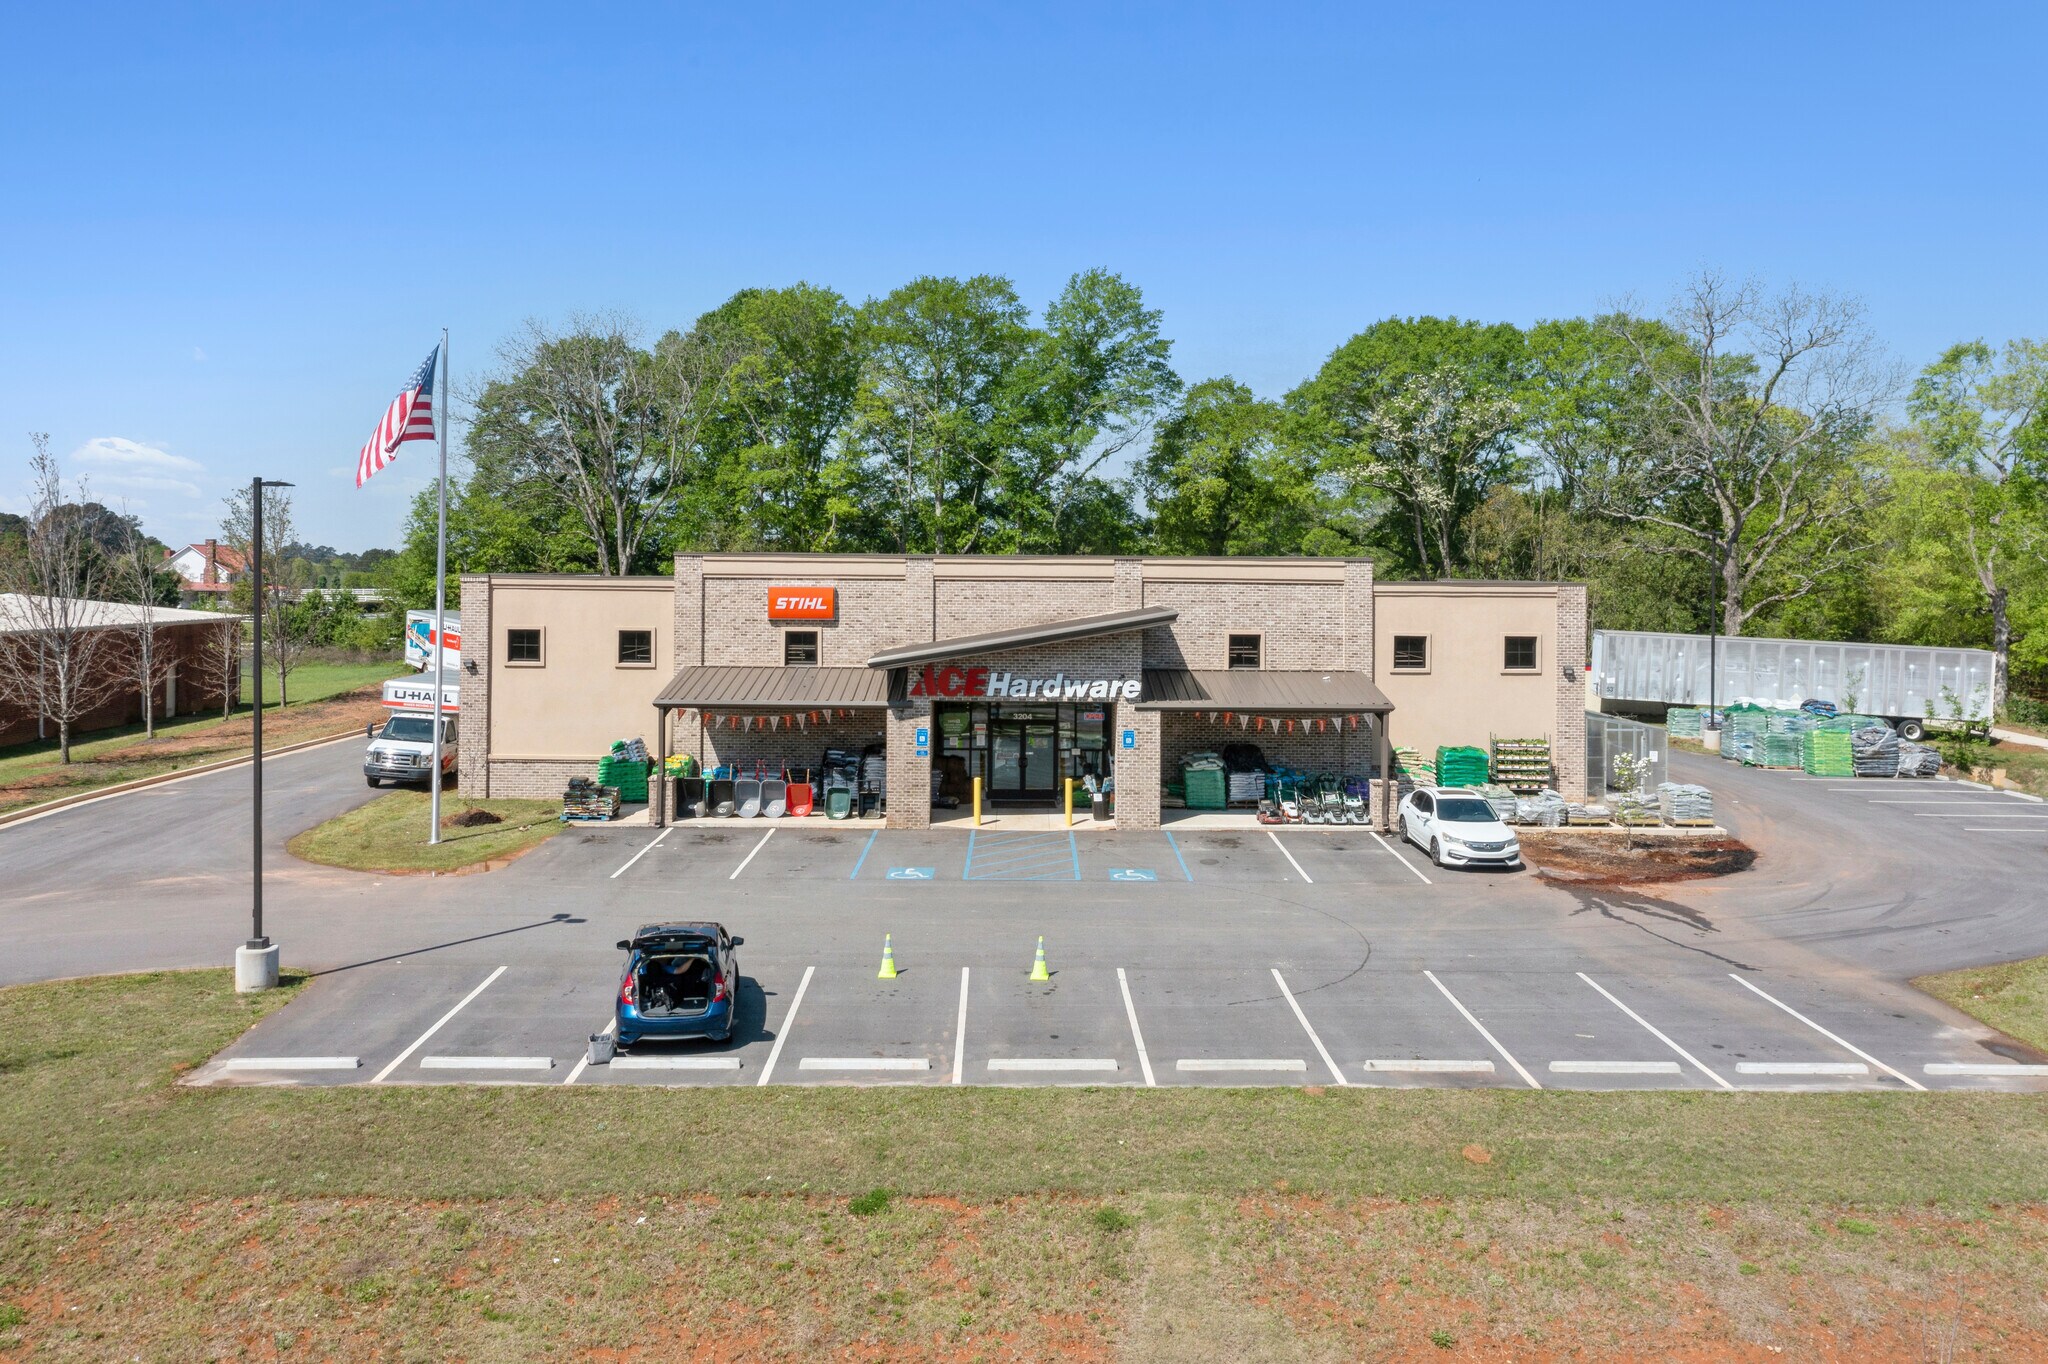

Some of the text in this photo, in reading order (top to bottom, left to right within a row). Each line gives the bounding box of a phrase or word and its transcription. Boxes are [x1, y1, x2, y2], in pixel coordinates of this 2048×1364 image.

[775, 597, 828, 610] STIHL
[909, 664, 1142, 698] ACE Hardware
[394, 690, 452, 703] U-HAL
